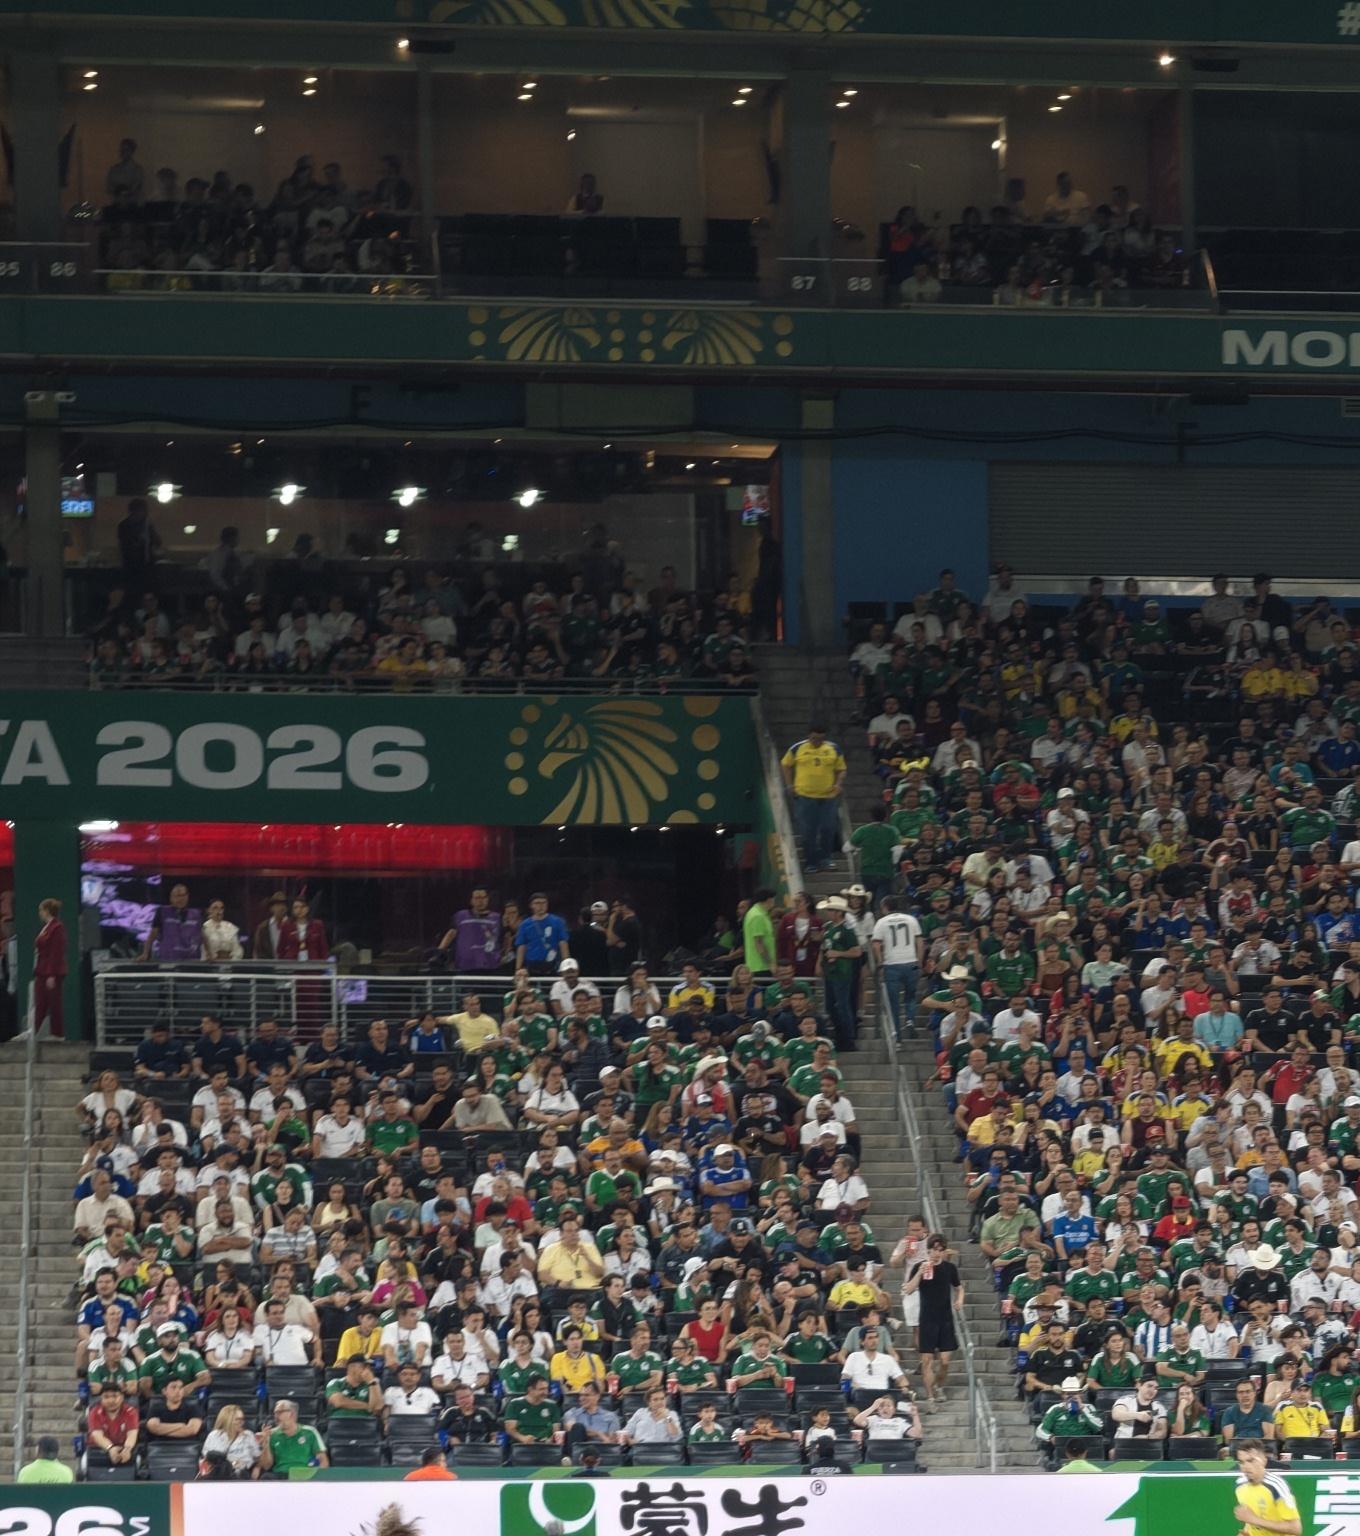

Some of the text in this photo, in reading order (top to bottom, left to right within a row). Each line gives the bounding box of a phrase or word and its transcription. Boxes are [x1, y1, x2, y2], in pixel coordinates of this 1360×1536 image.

[791, 275, 817, 291] 87
[0, 720, 430, 793] A 2026
[888, 922, 911, 947] 17
